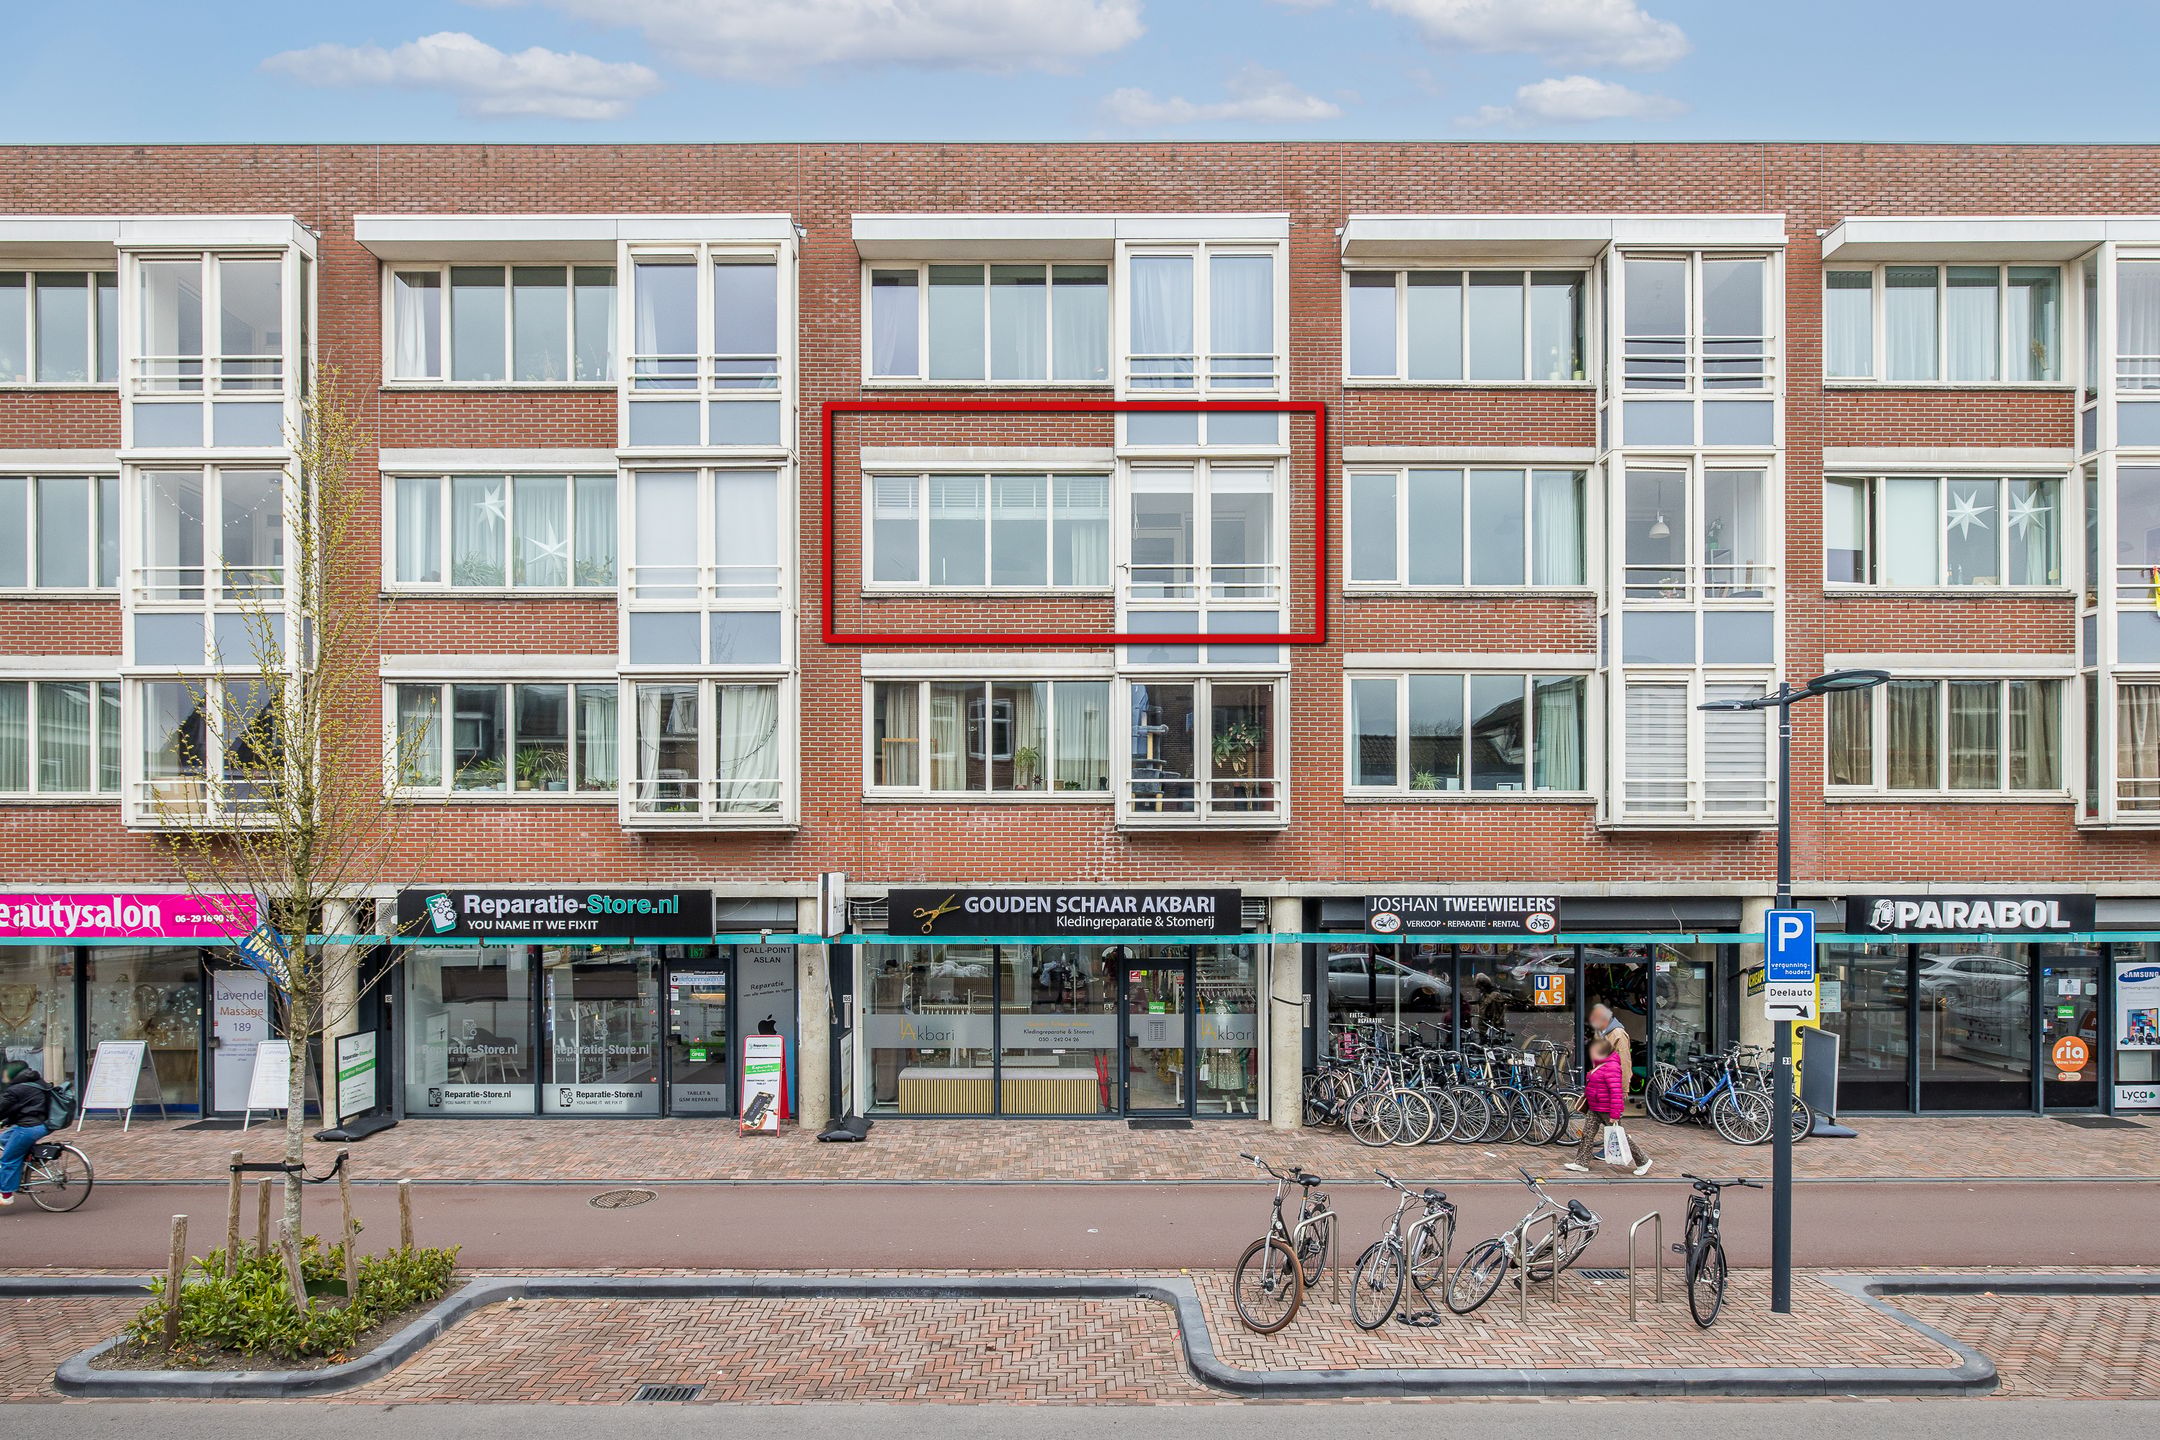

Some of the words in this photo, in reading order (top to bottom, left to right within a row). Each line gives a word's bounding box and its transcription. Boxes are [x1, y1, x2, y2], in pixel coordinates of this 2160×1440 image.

[463, 894, 679, 918] Reparatie-Store.nl
[964, 896, 1051, 913] GOUDEN
[1056, 896, 1137, 913] SCHAAR
[1141, 896, 1215, 913] AKBARI
[1370, 897, 1438, 912] JOSHAN
[1443, 897, 1556, 912] TWEEWIELERS
[1894, 900, 2071, 929] PARABOL
[468, 920, 497, 930] YOU
[499, 920, 530, 930] NAME
[532, 920, 544, 930] IT
[545, 920, 566, 930] WE
[1056, 916, 1152, 930] Kledingreparatie
[1155, 916, 1164, 927] &
[1166, 916, 1215, 930] Stomerij
[1406, 920, 1442, 928] VERKOOP
[1447, 920, 1486, 928] REPARATIE
[1492, 920, 1520, 928] RENTAL
[1778, 917, 1804, 952] P
[743, 946, 791, 954] CALL-POINT
[753, 956, 781, 964] ASLAN
[750, 980, 784, 991] Reparatie
[216, 989, 267, 1001] Lavendel
[1770, 988, 1813, 996] Deelauto
[220, 1007, 263, 1018] Massage
[233, 1022, 252, 1032] 189
[554, 1044, 649, 1056] Reparatie-Store.nl
[2056, 1041, 2084, 1059] ria
[444, 1090, 512, 1099] Reparatie-Store.nl
[576, 1090, 643, 1099] Reparatie-Store.nl
[2122, 1090, 2147, 1101] Lyca
